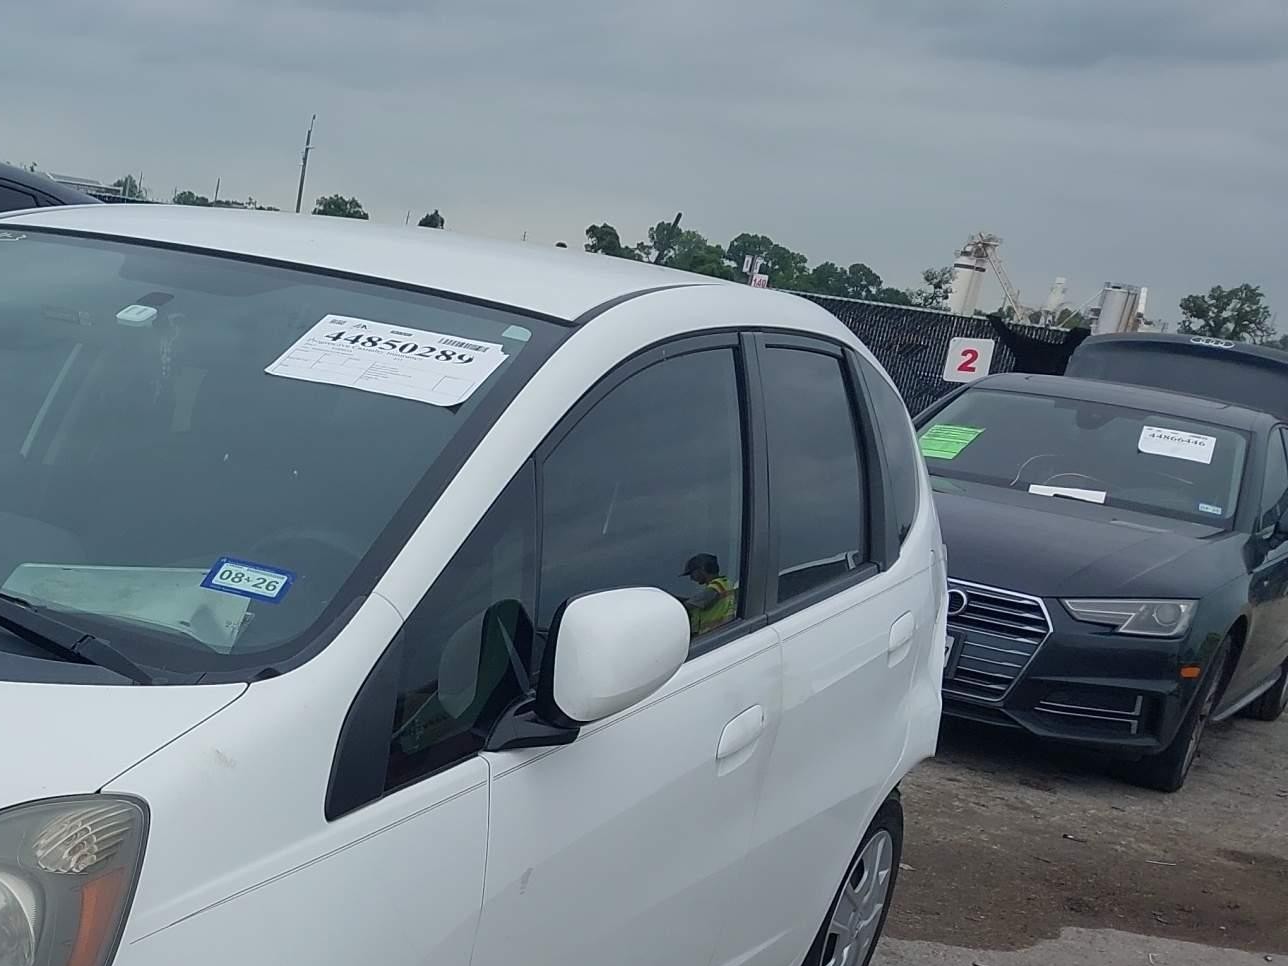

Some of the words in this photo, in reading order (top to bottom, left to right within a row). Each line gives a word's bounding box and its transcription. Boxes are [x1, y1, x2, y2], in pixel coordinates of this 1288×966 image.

[324, 330, 474, 364] 44850289
[957, 349, 979, 373] 2
[219, 569, 245, 584] 08
[252, 577, 280, 592] 26
